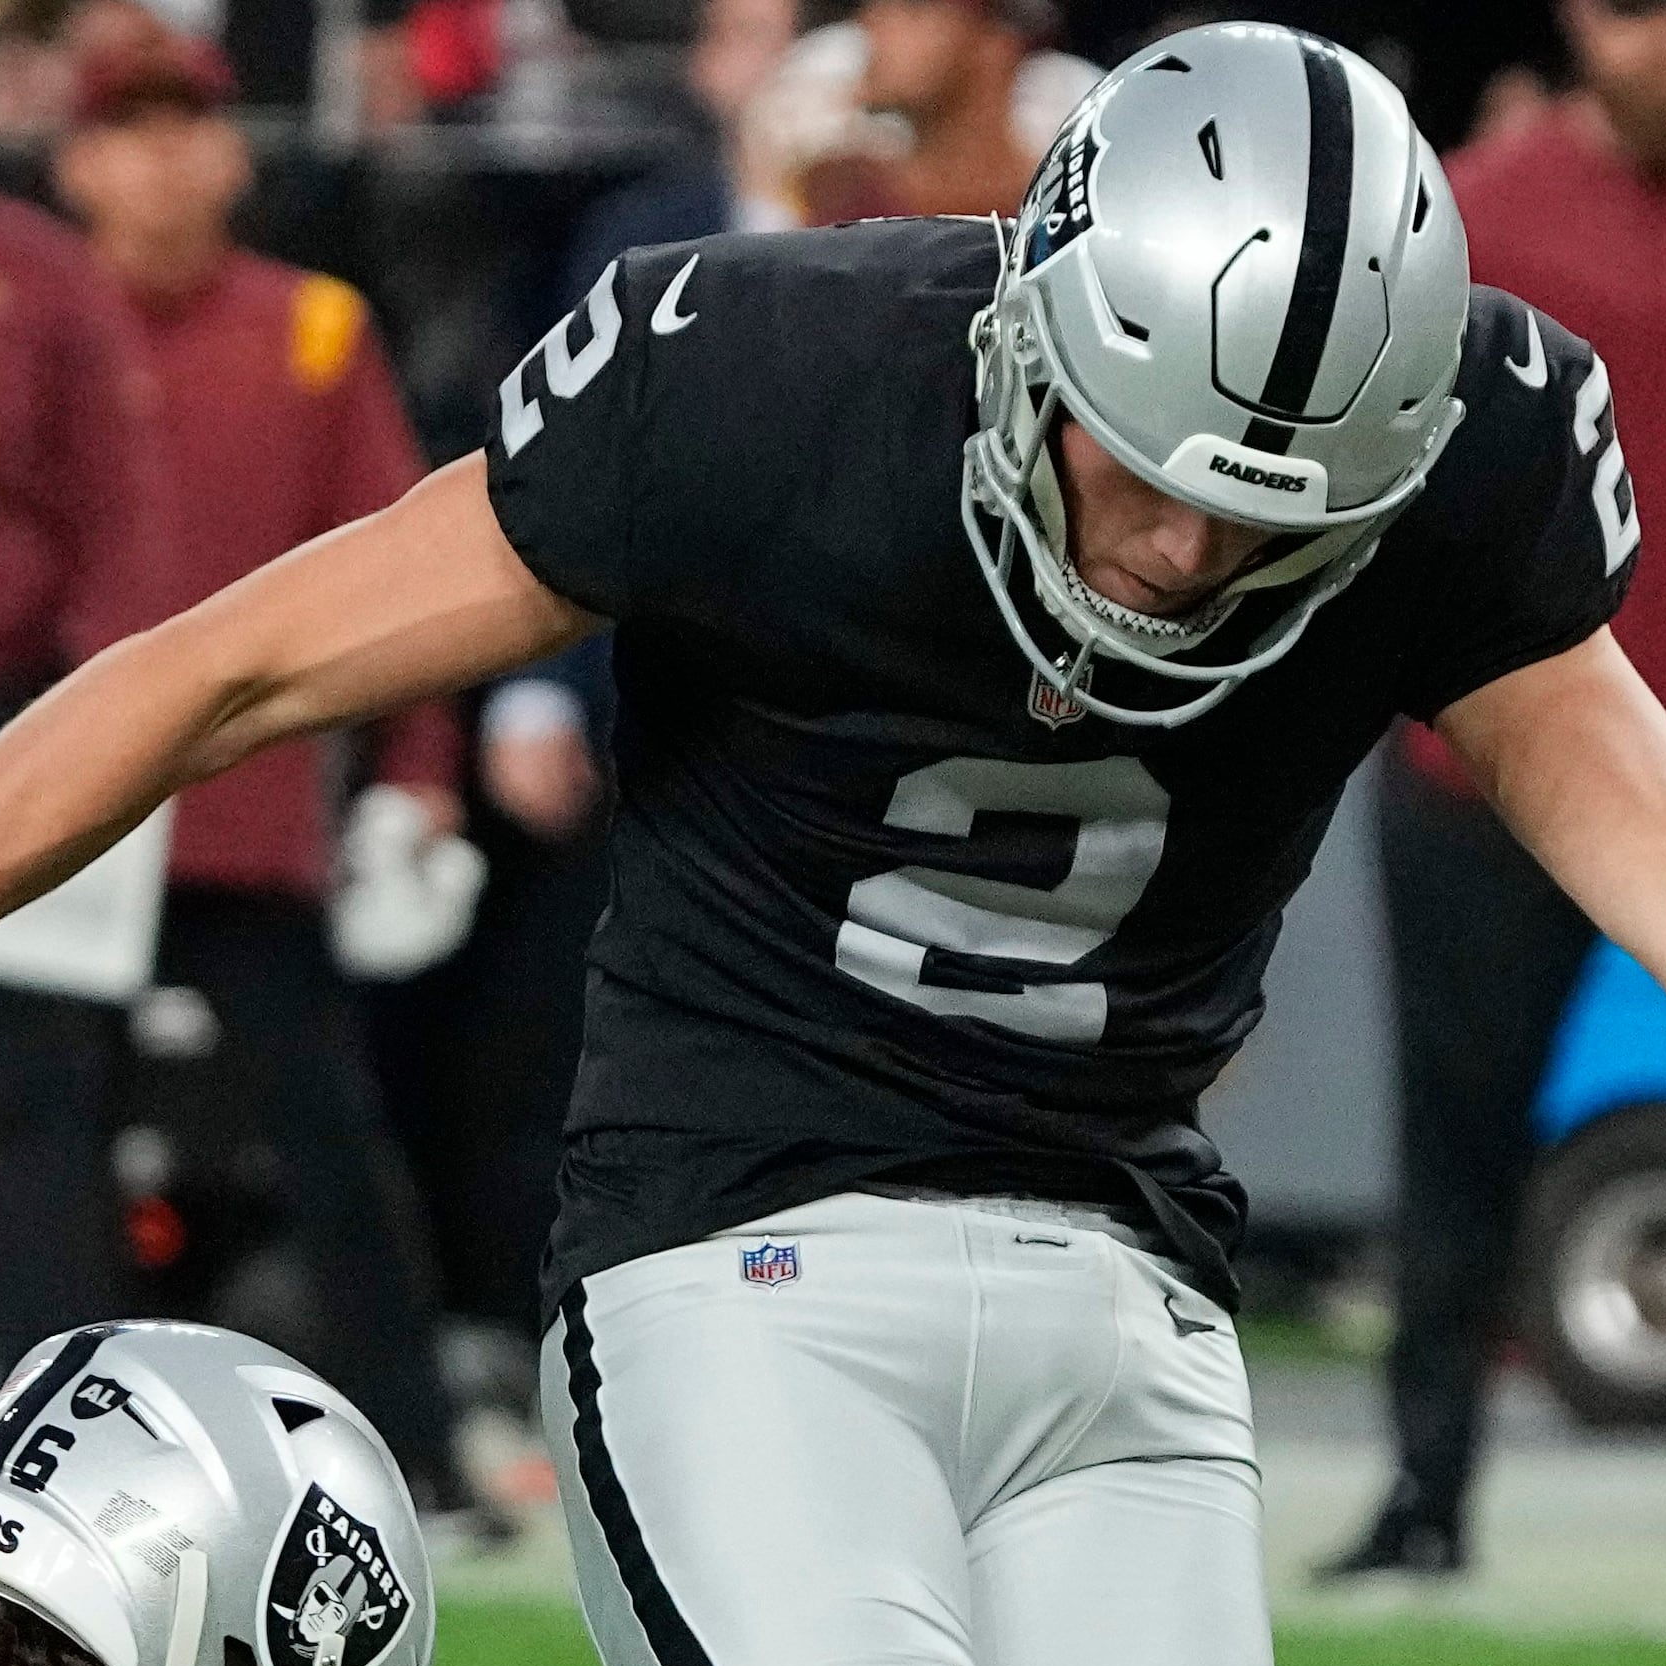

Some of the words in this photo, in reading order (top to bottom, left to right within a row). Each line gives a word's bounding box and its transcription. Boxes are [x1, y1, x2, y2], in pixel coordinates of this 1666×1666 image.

[1209, 454, 1309, 493] RAIDERS
[1573, 352, 1641, 578] 2
[835, 755, 1171, 1046] 2
[750, 1263, 792, 1280] NFL
[76, 1382, 117, 1410] AL
[10, 1423, 76, 1493] 6
[316, 1496, 403, 1609] RAIDERS
